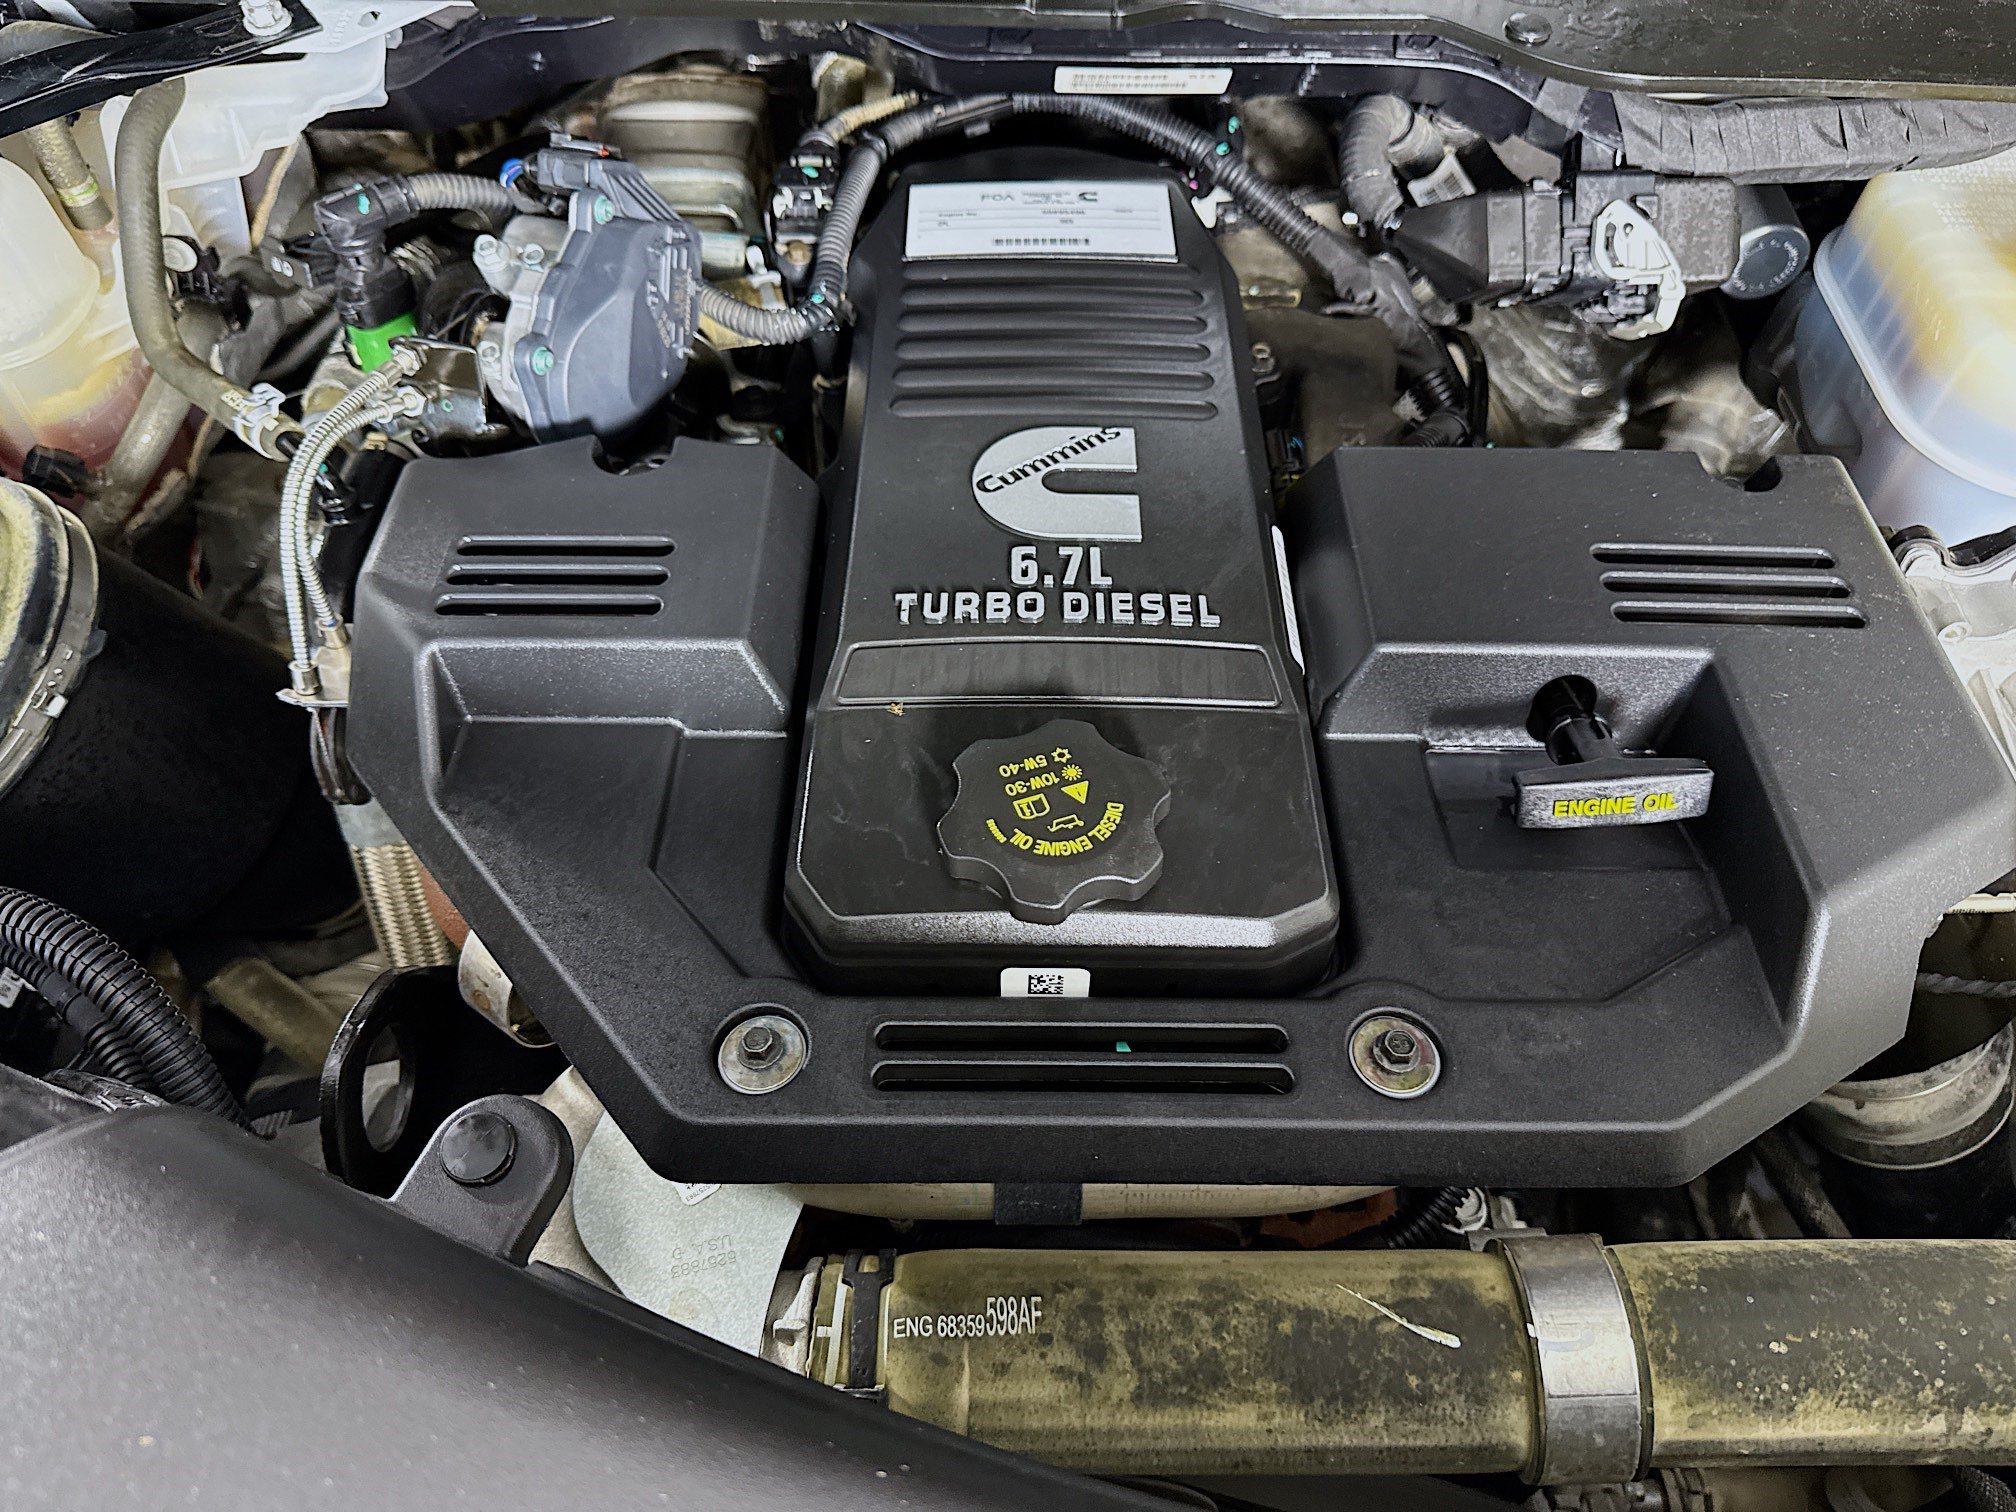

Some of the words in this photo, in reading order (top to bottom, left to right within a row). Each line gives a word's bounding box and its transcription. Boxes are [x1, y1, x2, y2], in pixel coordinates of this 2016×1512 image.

[976, 427, 1122, 493] Cummins
[1010, 545, 1113, 588] 6.7L
[894, 591, 1046, 625] TURBO
[1061, 591, 1221, 628] DIESEL
[998, 754, 1048, 778] 5W-40
[1004, 771, 1060, 796] 10W-30
[1552, 795, 1636, 817] ENGINE
[1642, 792, 1679, 812] OIL
[1088, 801, 1124, 842] DIESEL
[1009, 828, 1034, 851] OIL
[1033, 835, 1094, 857] ENGINE
[893, 1315, 933, 1339] ENG
